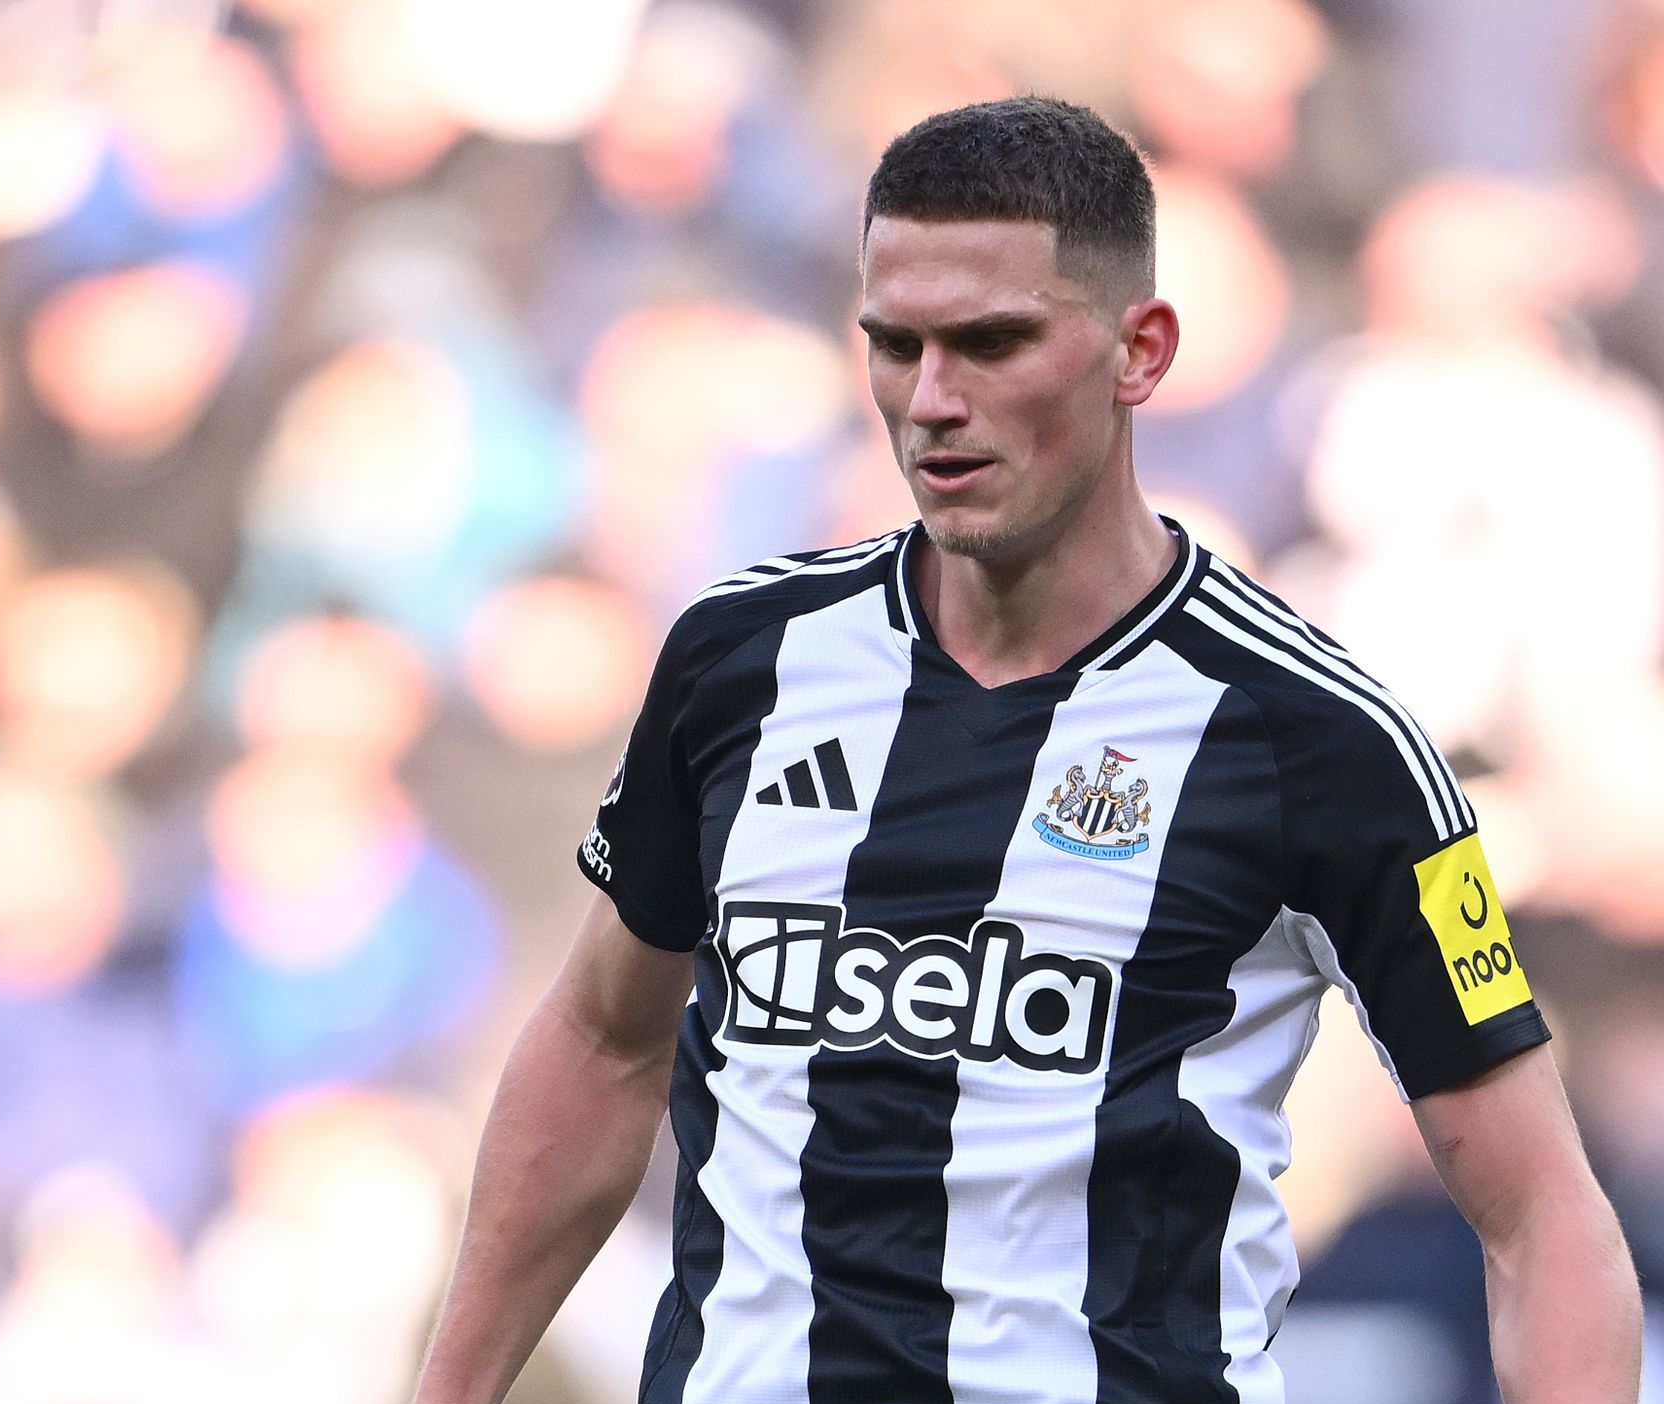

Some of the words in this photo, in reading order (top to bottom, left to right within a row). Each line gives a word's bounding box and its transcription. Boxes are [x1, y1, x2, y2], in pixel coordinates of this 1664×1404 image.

[1044, 832, 1094, 856] NEWCASTLE
[1095, 848, 1131, 857] UNITED
[1452, 938, 1523, 993] noo
[825, 936, 1097, 1060] sela
